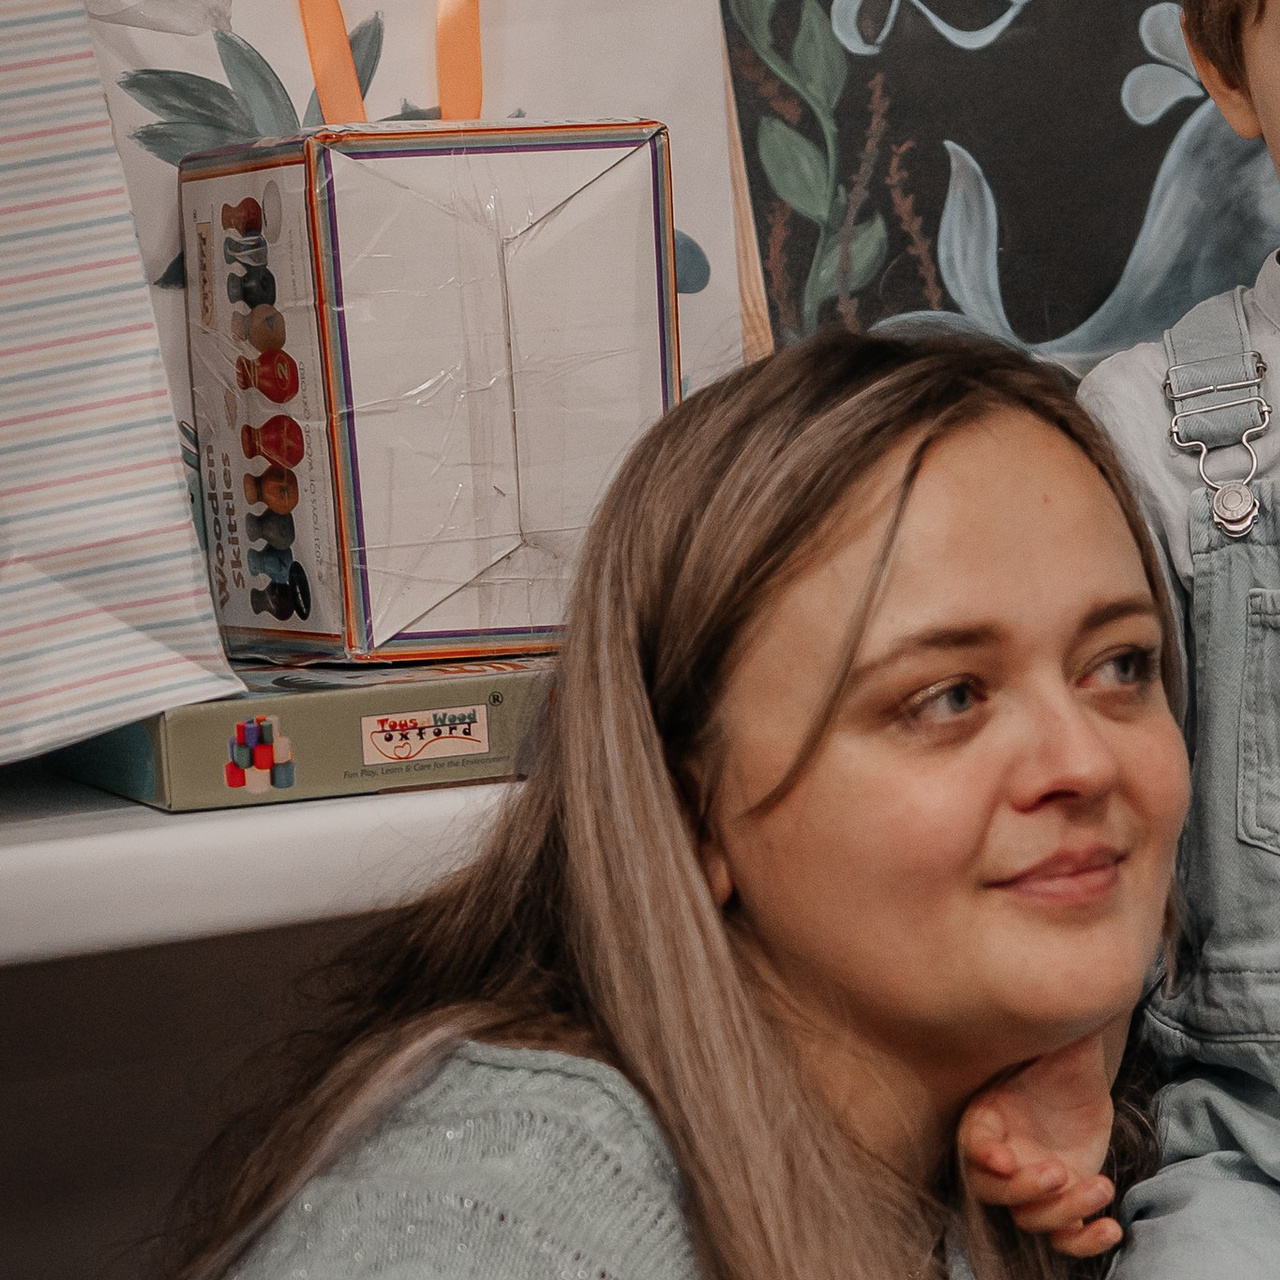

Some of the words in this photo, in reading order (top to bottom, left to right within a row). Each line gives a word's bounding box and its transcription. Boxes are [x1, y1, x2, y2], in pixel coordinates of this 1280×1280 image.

[206, 445, 231, 609] Wooden
[221, 452, 246, 590] Skittles
[377, 717, 419, 731] Toys
[432, 709, 477, 726] Wood
[384, 723, 472, 742] oxford
